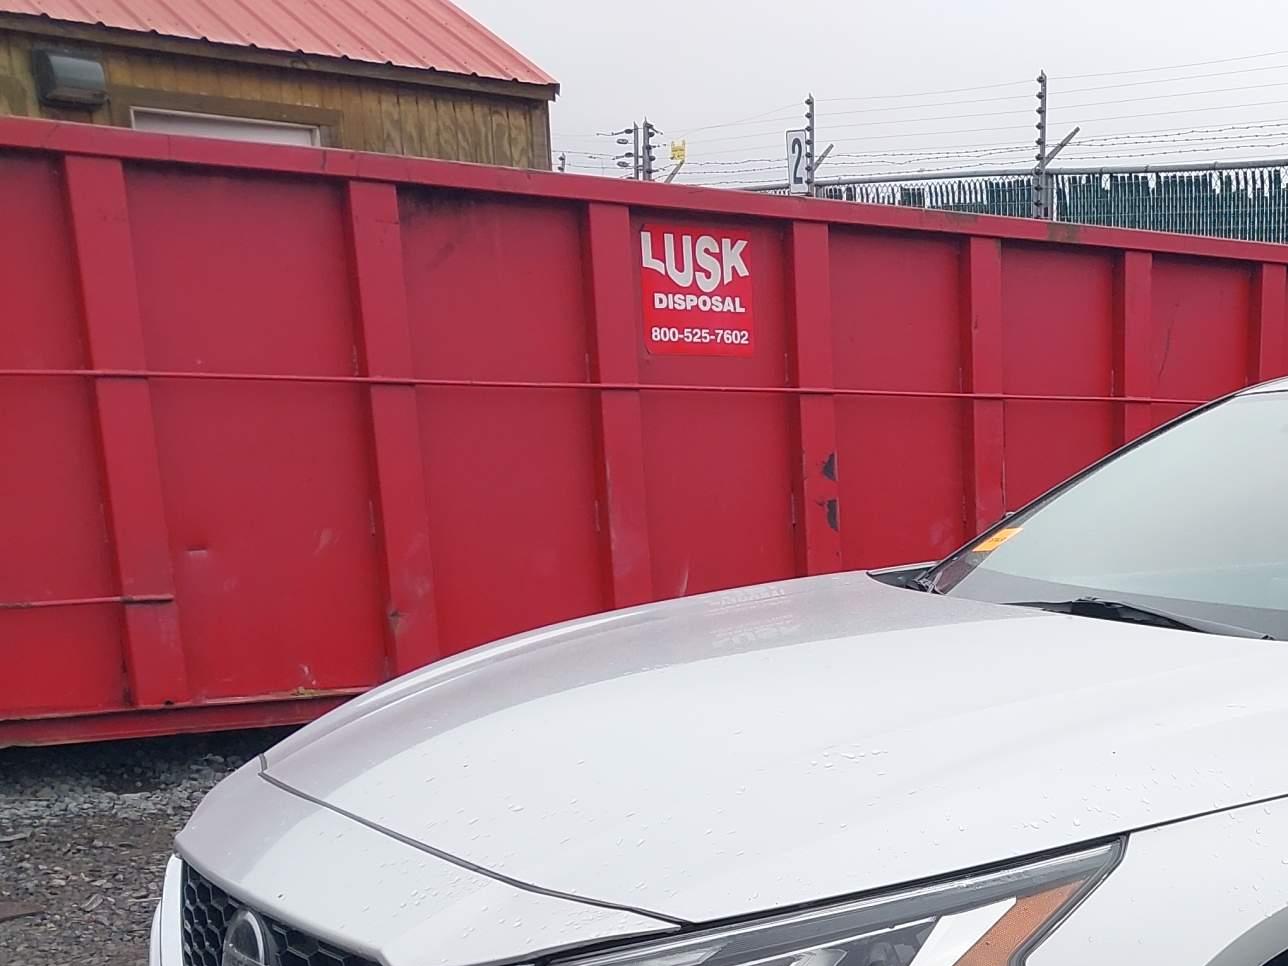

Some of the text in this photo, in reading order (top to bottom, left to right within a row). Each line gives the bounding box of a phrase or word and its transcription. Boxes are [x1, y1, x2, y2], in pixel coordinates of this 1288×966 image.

[791, 137, 803, 184] 2
[640, 231, 750, 293] LUSK
[654, 294, 746, 313] DISPOSAL
[651, 326, 749, 345] 800-525-7602
